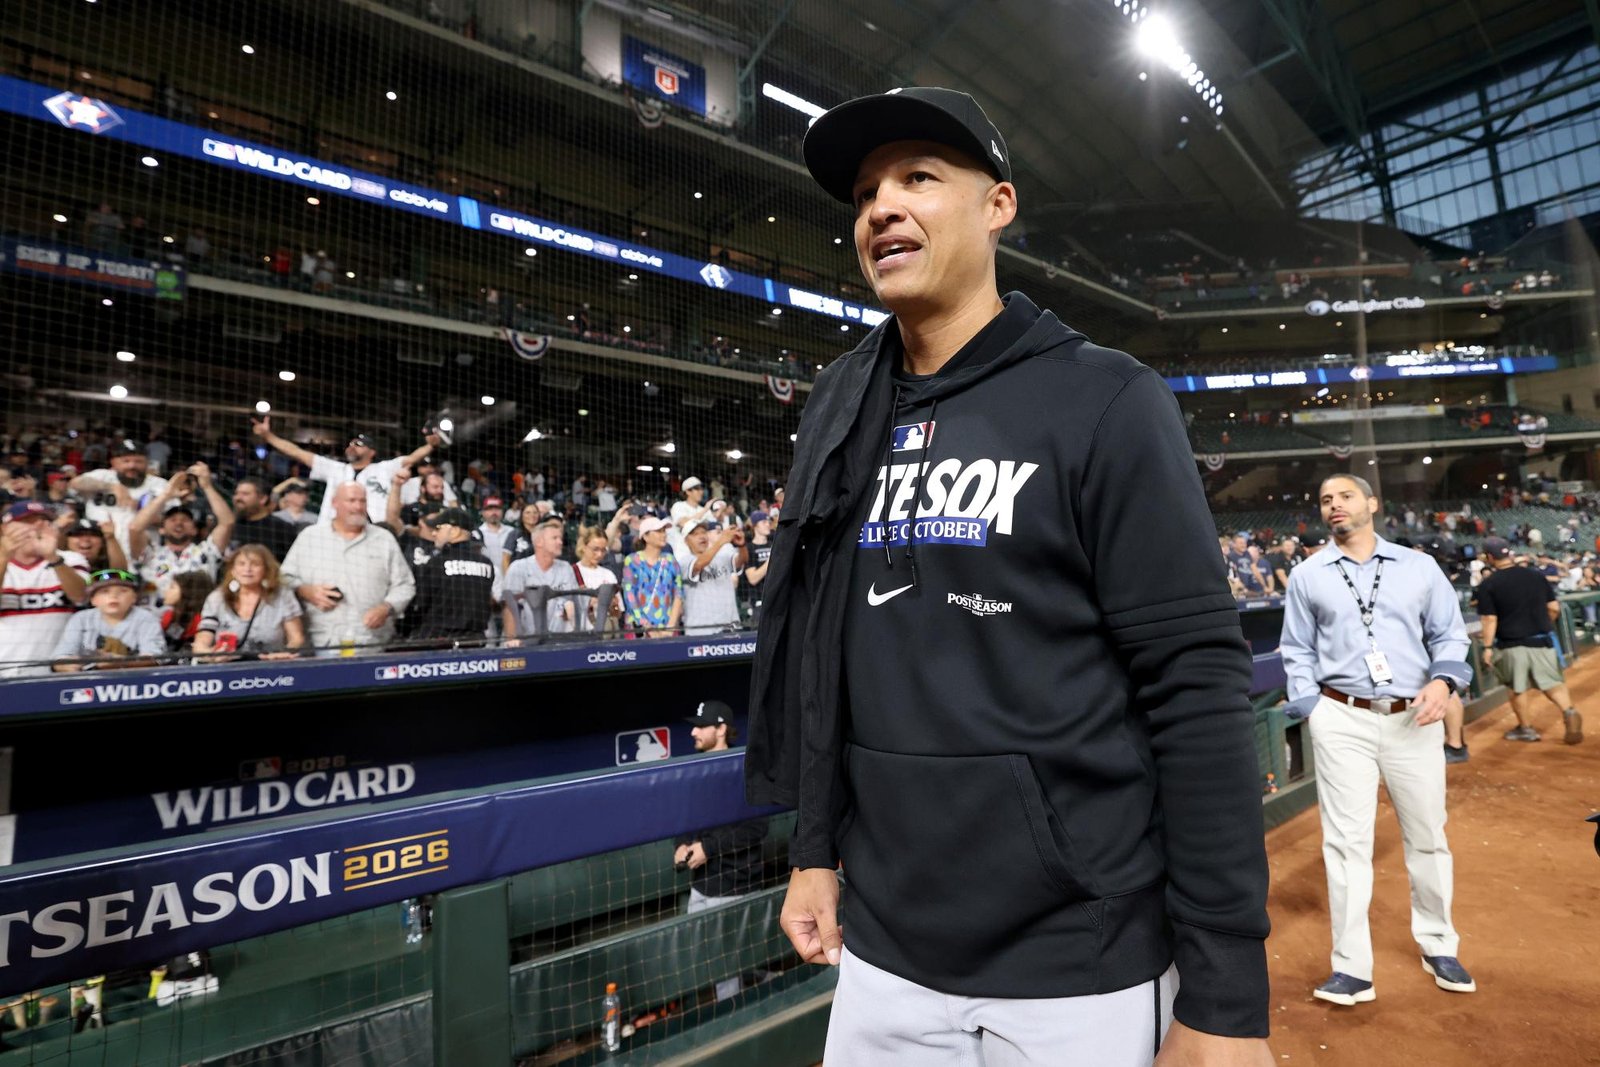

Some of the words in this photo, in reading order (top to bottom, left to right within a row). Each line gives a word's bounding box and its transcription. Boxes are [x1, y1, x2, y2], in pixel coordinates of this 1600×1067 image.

[900, 520, 982, 541] OCTOBER
[444, 560, 492, 579] SECURITY
[947, 592, 1012, 613] POSTSEASON
[587, 650, 637, 663] abbvie
[398, 659, 499, 679] POSTSEASON
[228, 674, 294, 691] abbvie
[286, 755, 346, 774] 2026
[343, 839, 449, 881] 2026
